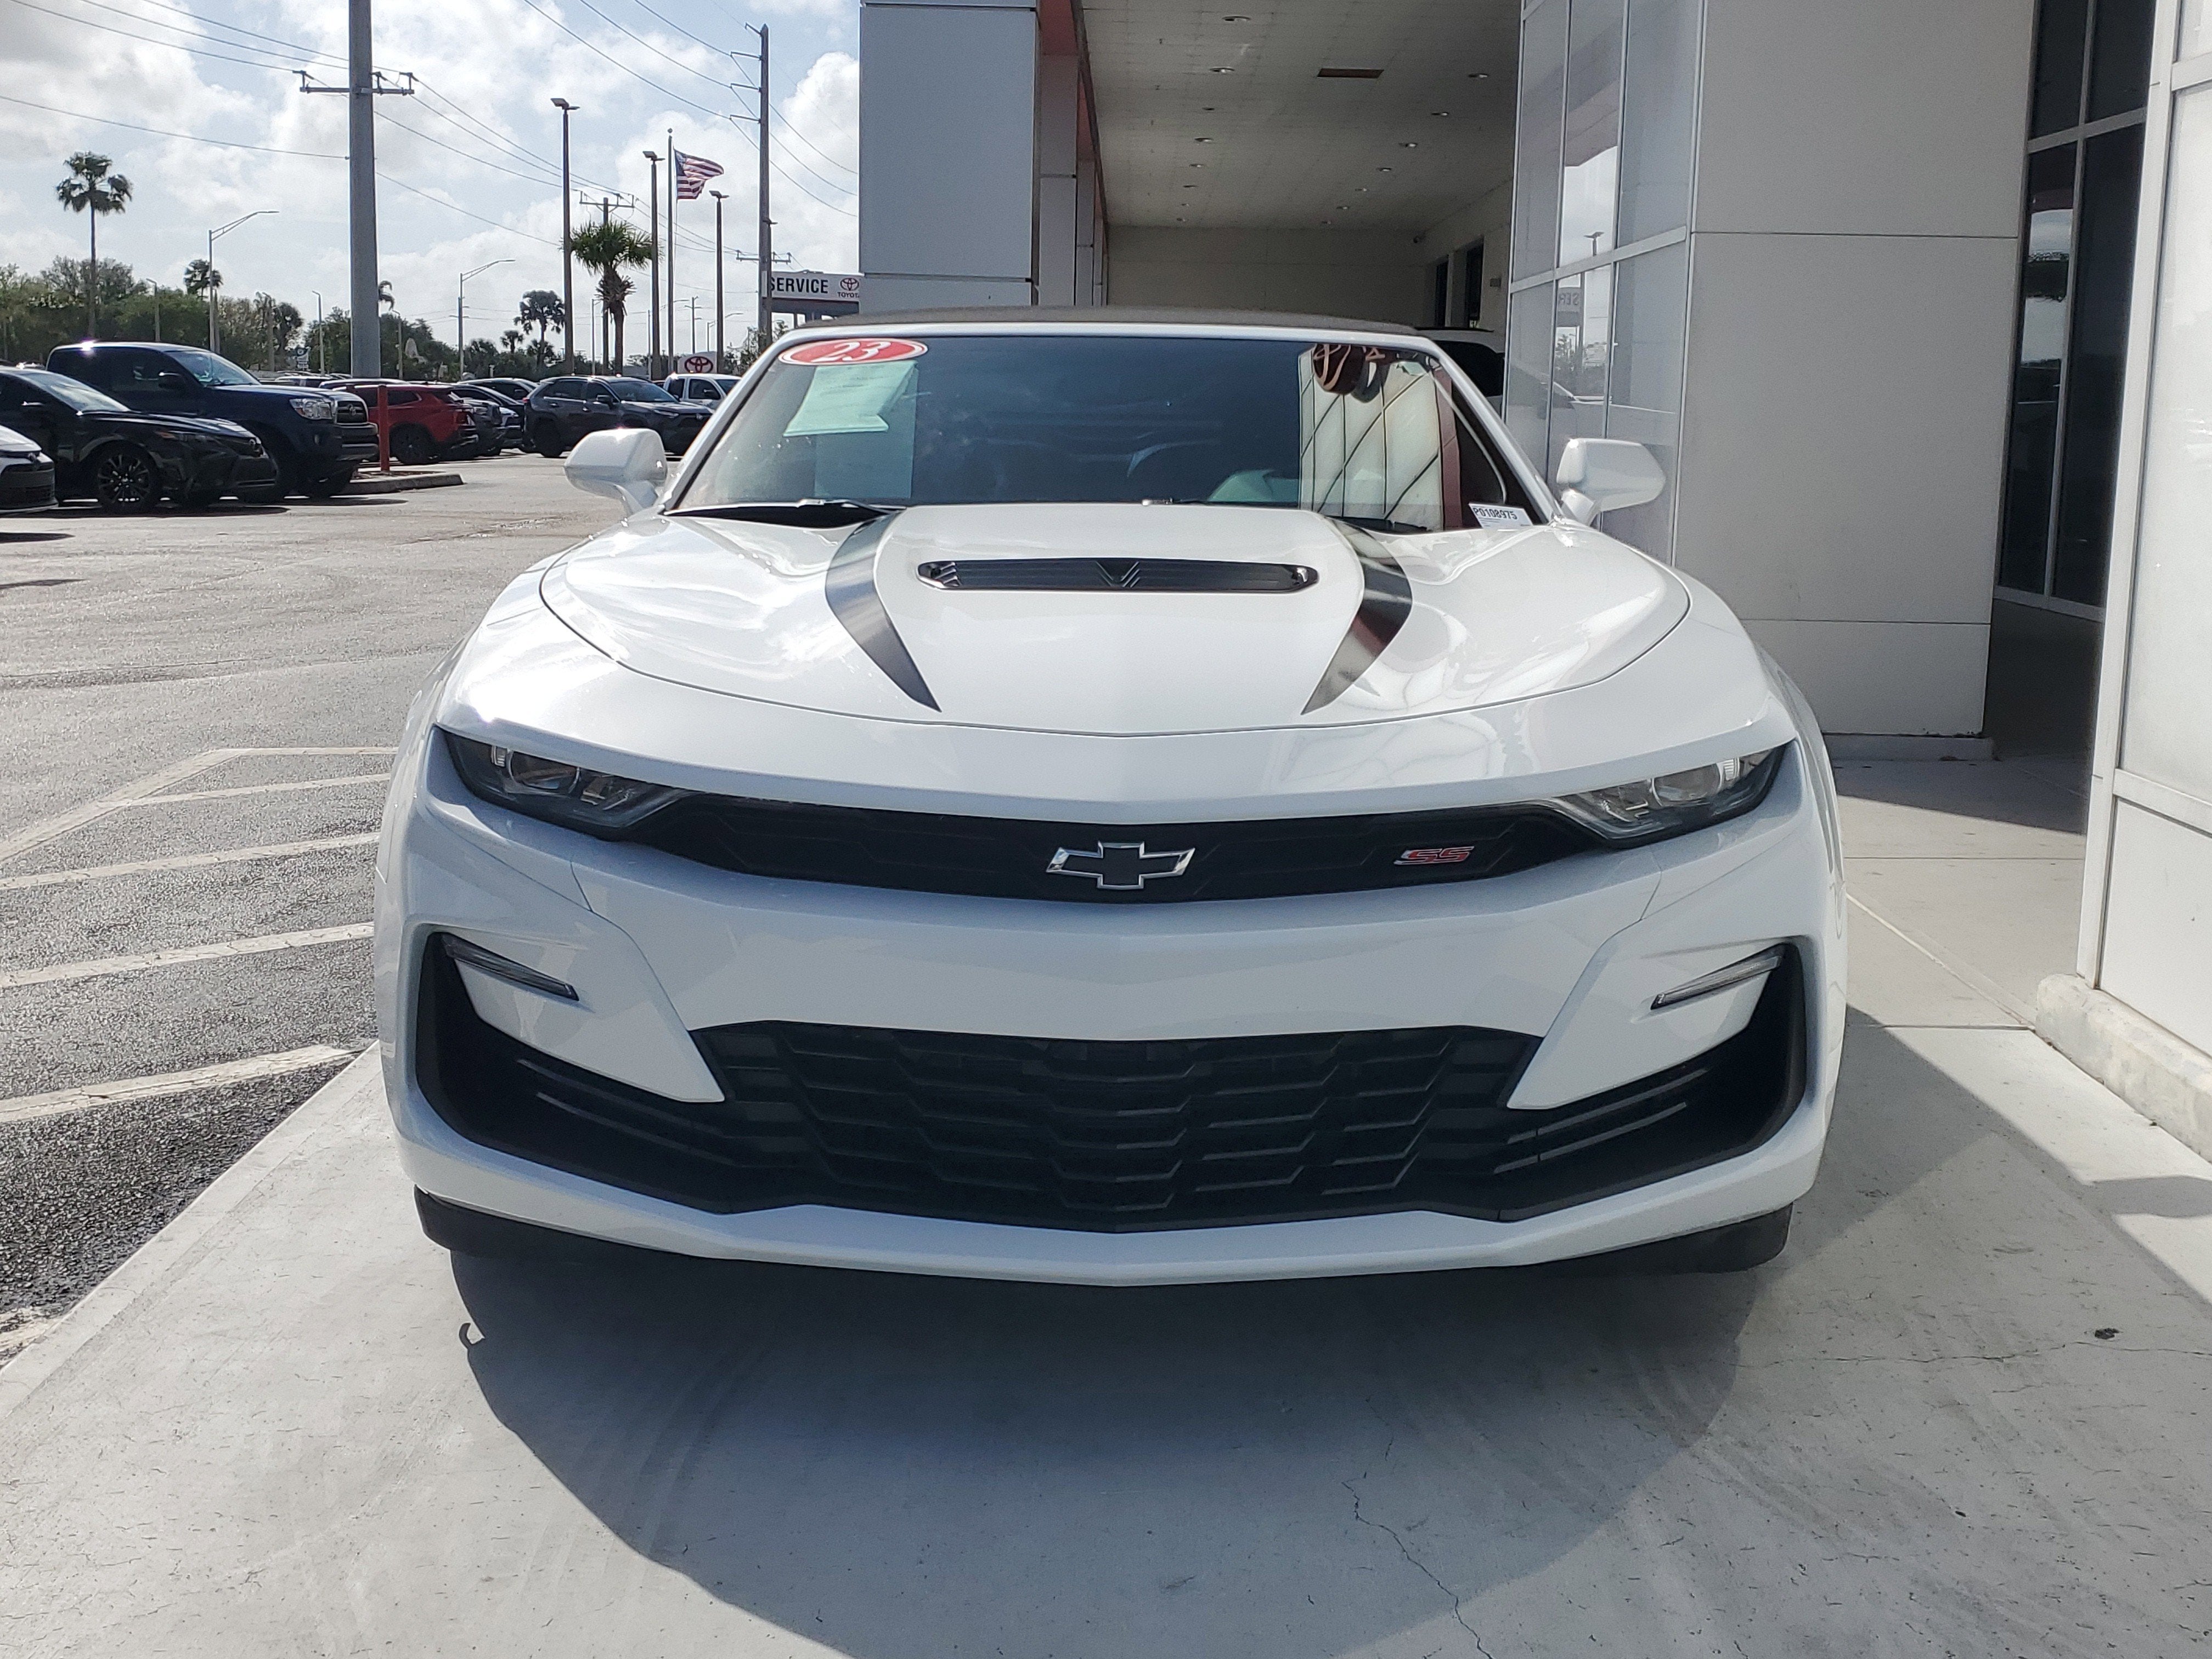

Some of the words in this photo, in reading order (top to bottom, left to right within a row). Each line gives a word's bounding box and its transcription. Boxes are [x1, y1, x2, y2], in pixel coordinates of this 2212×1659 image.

[771, 277, 828, 294] SERVICE
[811, 341, 891, 362] 23
[1393, 845, 1475, 865] SS
